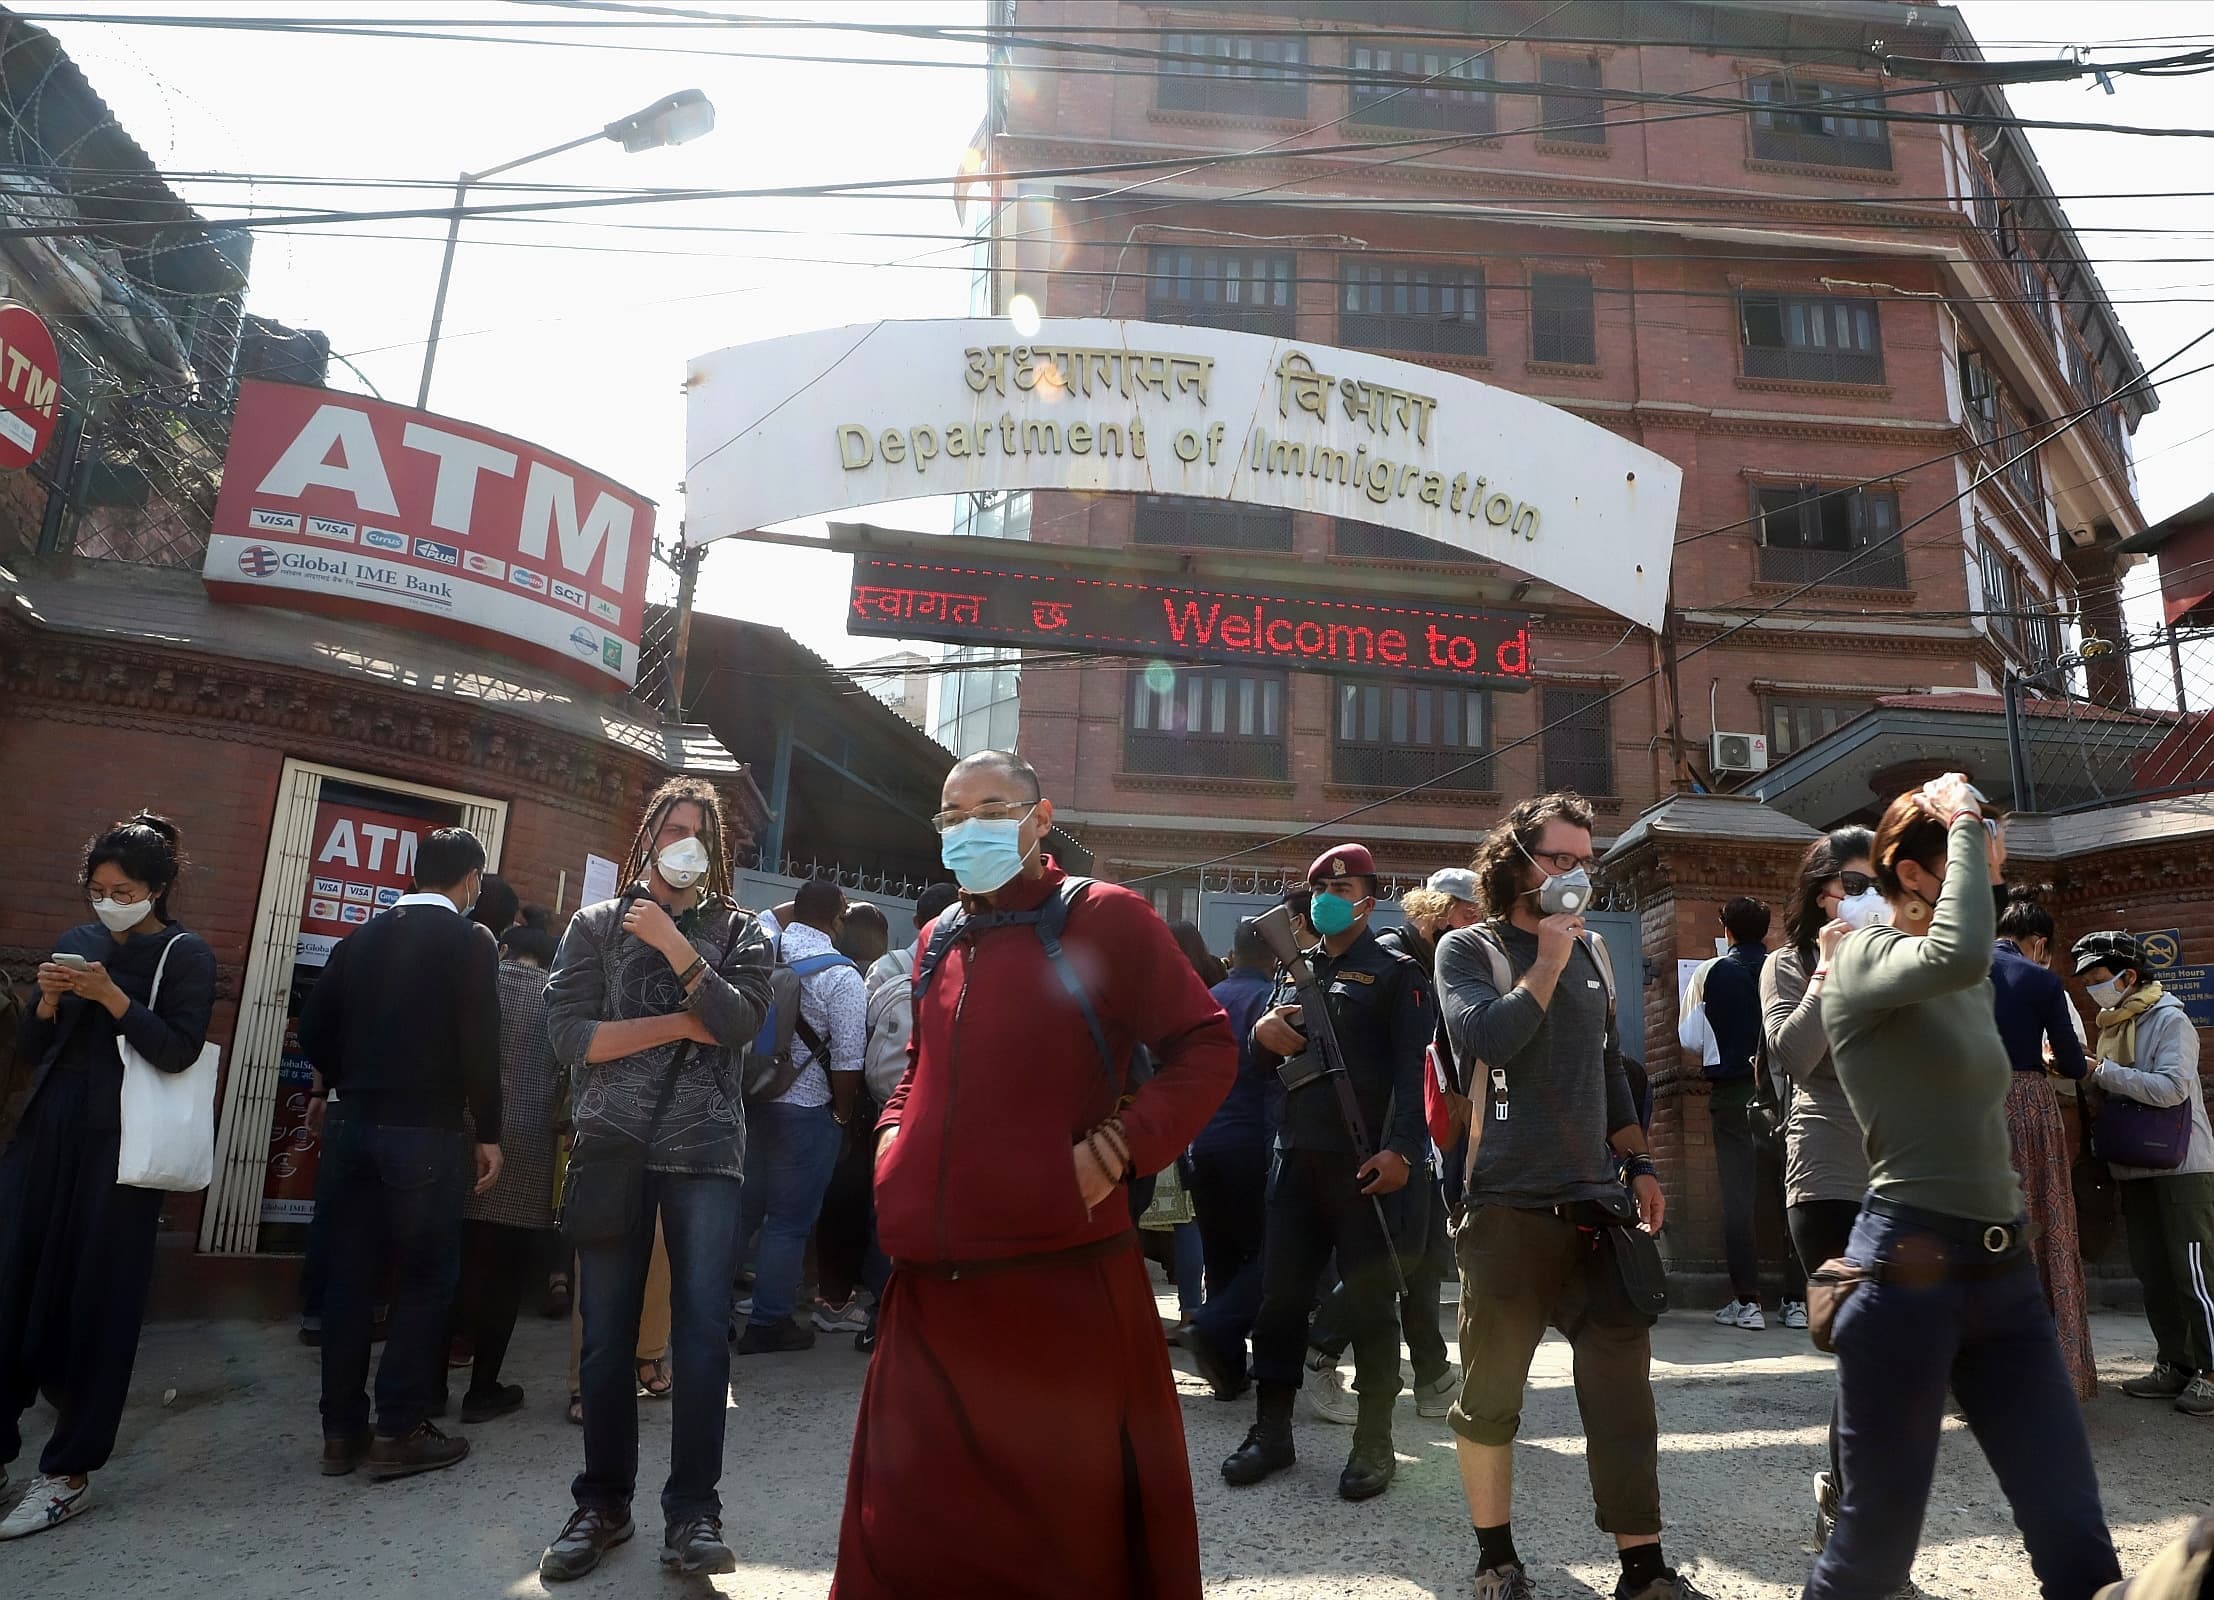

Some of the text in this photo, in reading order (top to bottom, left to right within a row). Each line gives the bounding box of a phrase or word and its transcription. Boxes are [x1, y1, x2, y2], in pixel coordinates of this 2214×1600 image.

[0, 338, 57, 419] TM
[964, 345, 1437, 446] अध्यागमन विभाग
[256, 404, 634, 594] ATM
[836, 410, 1541, 541] Department of Immigration
[259, 514, 294, 528] VISA
[316, 521, 349, 536] VISA
[368, 533, 402, 549] Cirrus
[427, 551, 455, 565] PLUS
[282, 553, 347, 576] Global
[356, 564, 398, 585] IME
[405, 574, 453, 598] Bank
[853, 585, 987, 623] स्वागत
[1164, 598, 1526, 673] Welcome to d
[318, 882, 339, 893] VISA
[350, 886, 369, 898] VISA
[2153, 971, 2176, 979] rking
